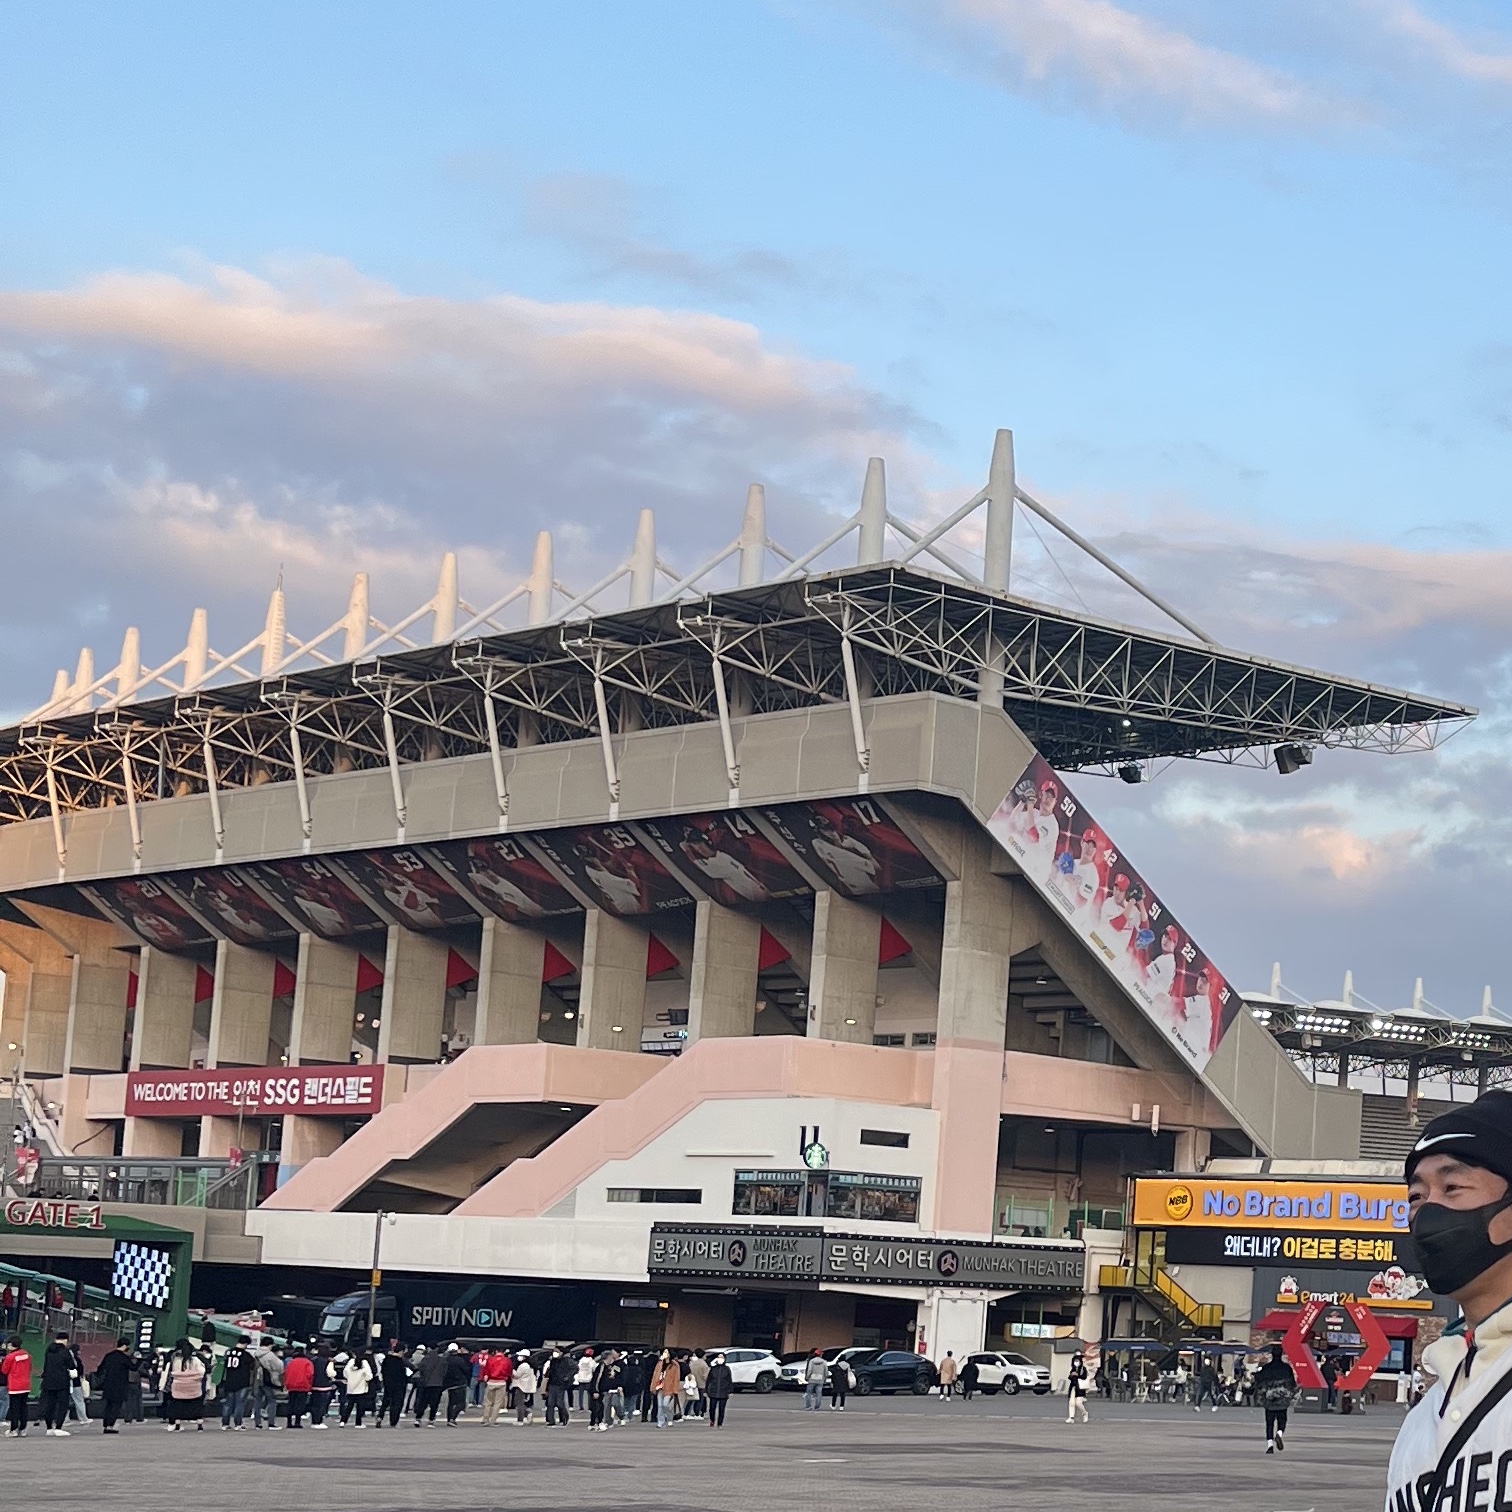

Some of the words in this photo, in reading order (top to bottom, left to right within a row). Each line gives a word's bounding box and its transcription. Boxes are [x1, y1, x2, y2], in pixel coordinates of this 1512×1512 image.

[851, 800, 882, 826] 17
[1060, 795, 1077, 818] 50
[723, 813, 756, 839] 14
[603, 826, 637, 850] 35
[392, 851, 425, 873] 53
[494, 839, 525, 862] 27
[1103, 848, 1118, 868] 42
[301, 860, 333, 881] 54
[135, 879, 163, 899] 20
[1148, 902, 1162, 921] 51
[1180, 942, 1197, 963] 22
[1218, 986, 1231, 1006] 31
[133, 1082, 189, 1102] WELCOME
[190, 1082, 206, 1101] TO
[206, 1081, 229, 1101] THE
[232, 1079, 262, 1106] 인천
[264, 1077, 300, 1105] SSG
[303, 1076, 374, 1106] 랜더스필드
[6, 1200, 81, 1228] GATE
[88, 1205, 107, 1230] 1
[1203, 1190, 1241, 1216] No
[1245, 1190, 1332, 1219] Brand
[652, 1239, 726, 1264] 문학시어터
[752, 1238, 799, 1252] MUNHAK
[1223, 1235, 1281, 1258] 왜더내?
[1283, 1236, 1337, 1259] 이걸로
[1338, 1237, 1398, 1261] 충분해.
[751, 1253, 814, 1273] THEATRE
[829, 1244, 935, 1272] 문학시어터
[963, 1255, 1016, 1273] MUNHAK
[1018, 1258, 1083, 1278] THEATRE
[227, 1356, 239, 1368] 10
